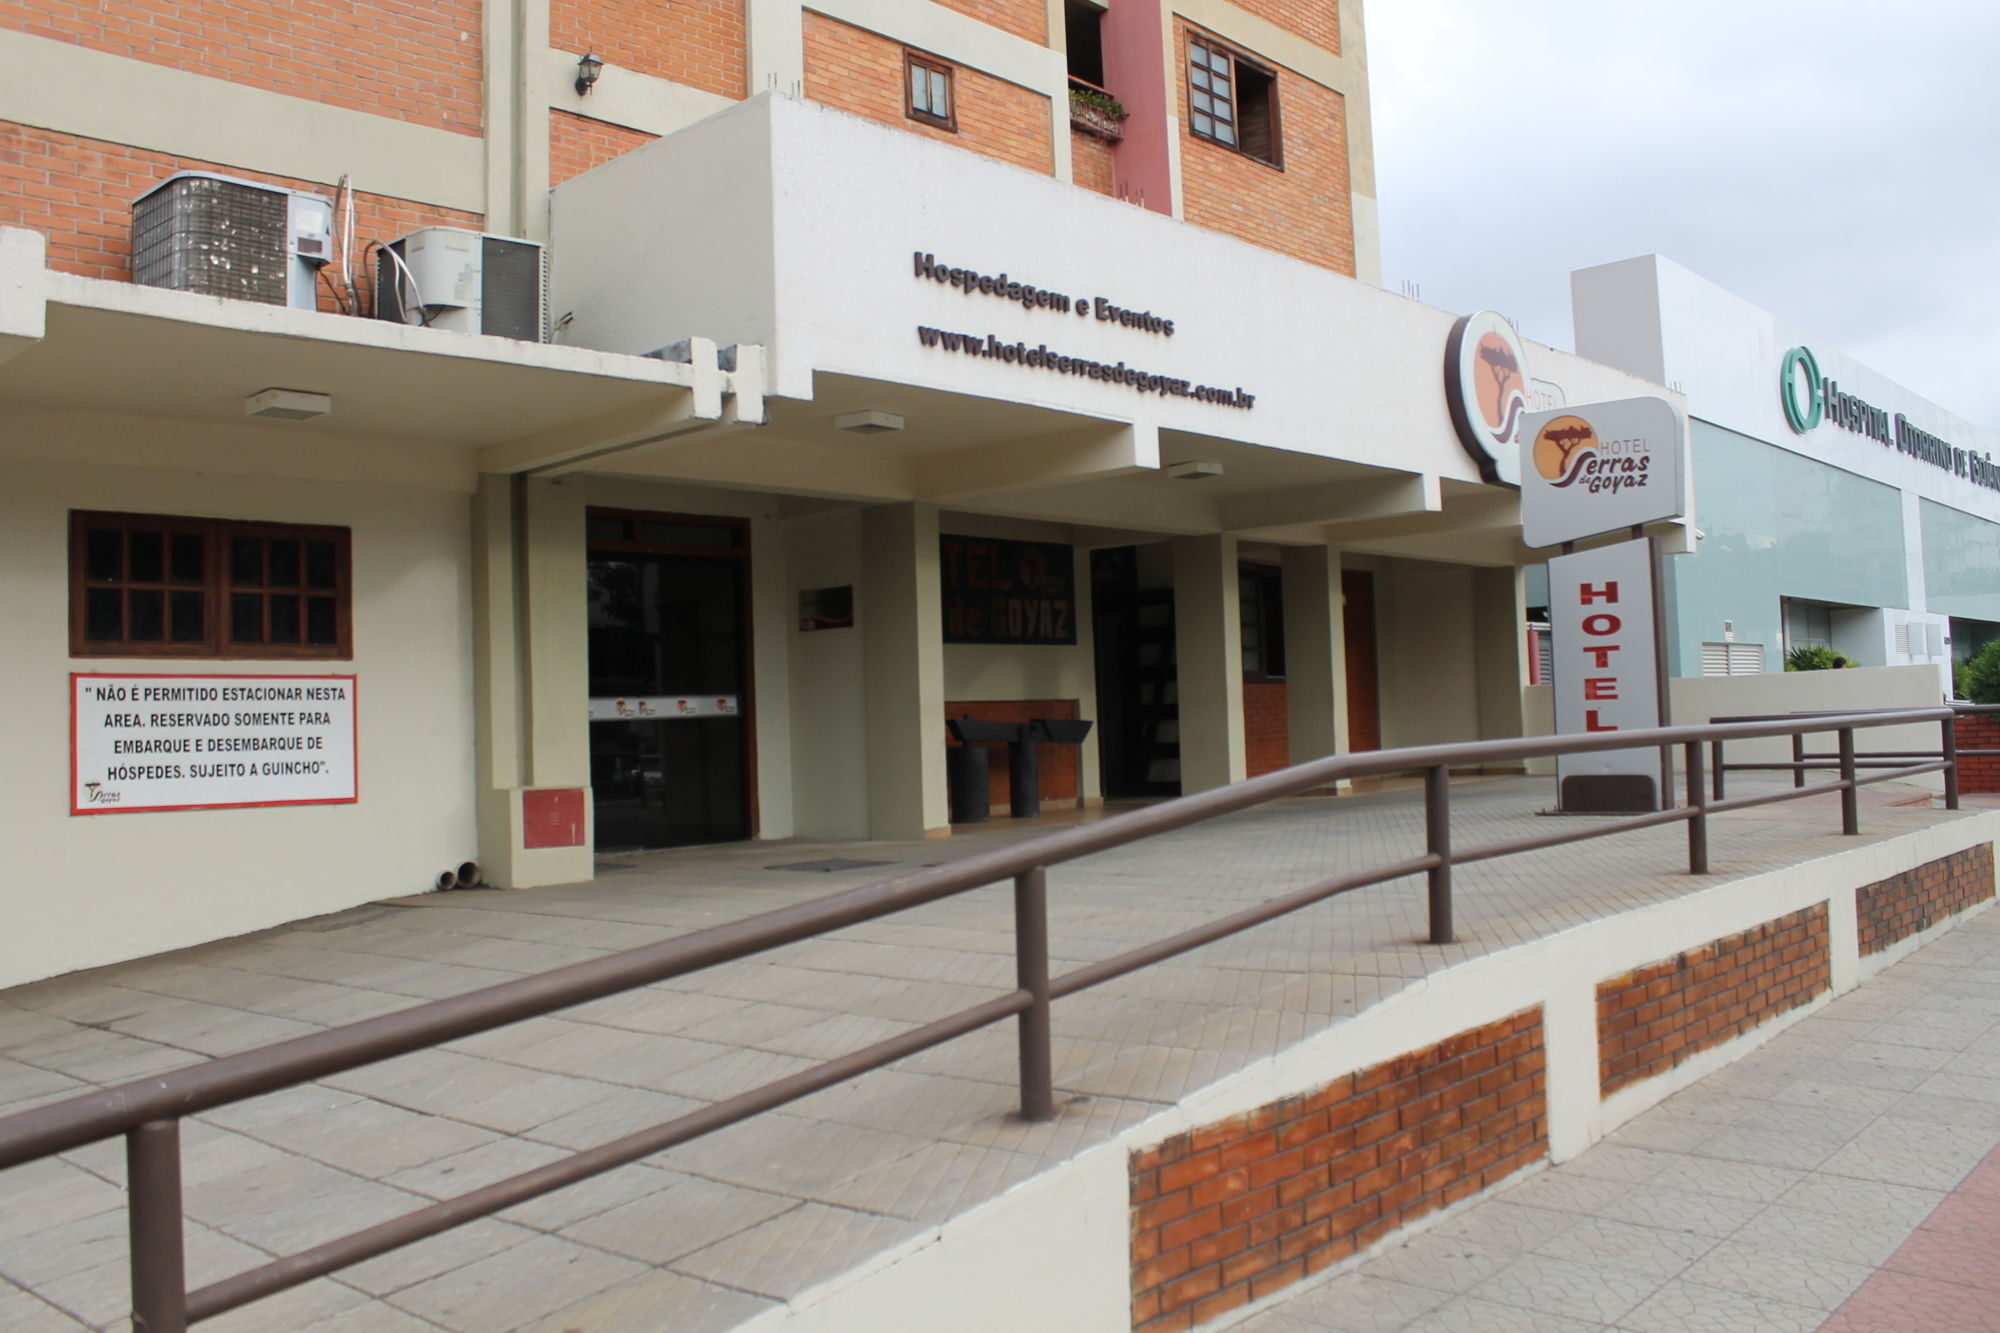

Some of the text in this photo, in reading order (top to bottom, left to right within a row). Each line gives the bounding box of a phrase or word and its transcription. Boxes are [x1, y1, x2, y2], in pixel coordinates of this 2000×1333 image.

[914, 251, 1174, 338] Hospedagem e Eventos
[918, 325, 1256, 410] www.hotelserrasdegoyaz.com.br
[1822, 376, 1894, 448] HOSPITAL
[1600, 438, 1650, 455] HOTEL
[1549, 451, 1650, 488] Serras
[1580, 581, 1622, 732] HOTEL
[131, 683, 139, 701] É
[144, 687, 218, 701] PERMITIDO
[222, 687, 302, 701] ESTACIONAR
[306, 687, 346, 700] NESTA
[104, 712, 331, 728] AREA. RESERVADO SOMENTE PARA
[114, 736, 323, 754] EMBARQUE E DESEMBARQUE DE
[107, 763, 185, 781] HÓSPEDES.
[189, 763, 245, 778] SUJEITO
[249, 763, 258, 776] A
